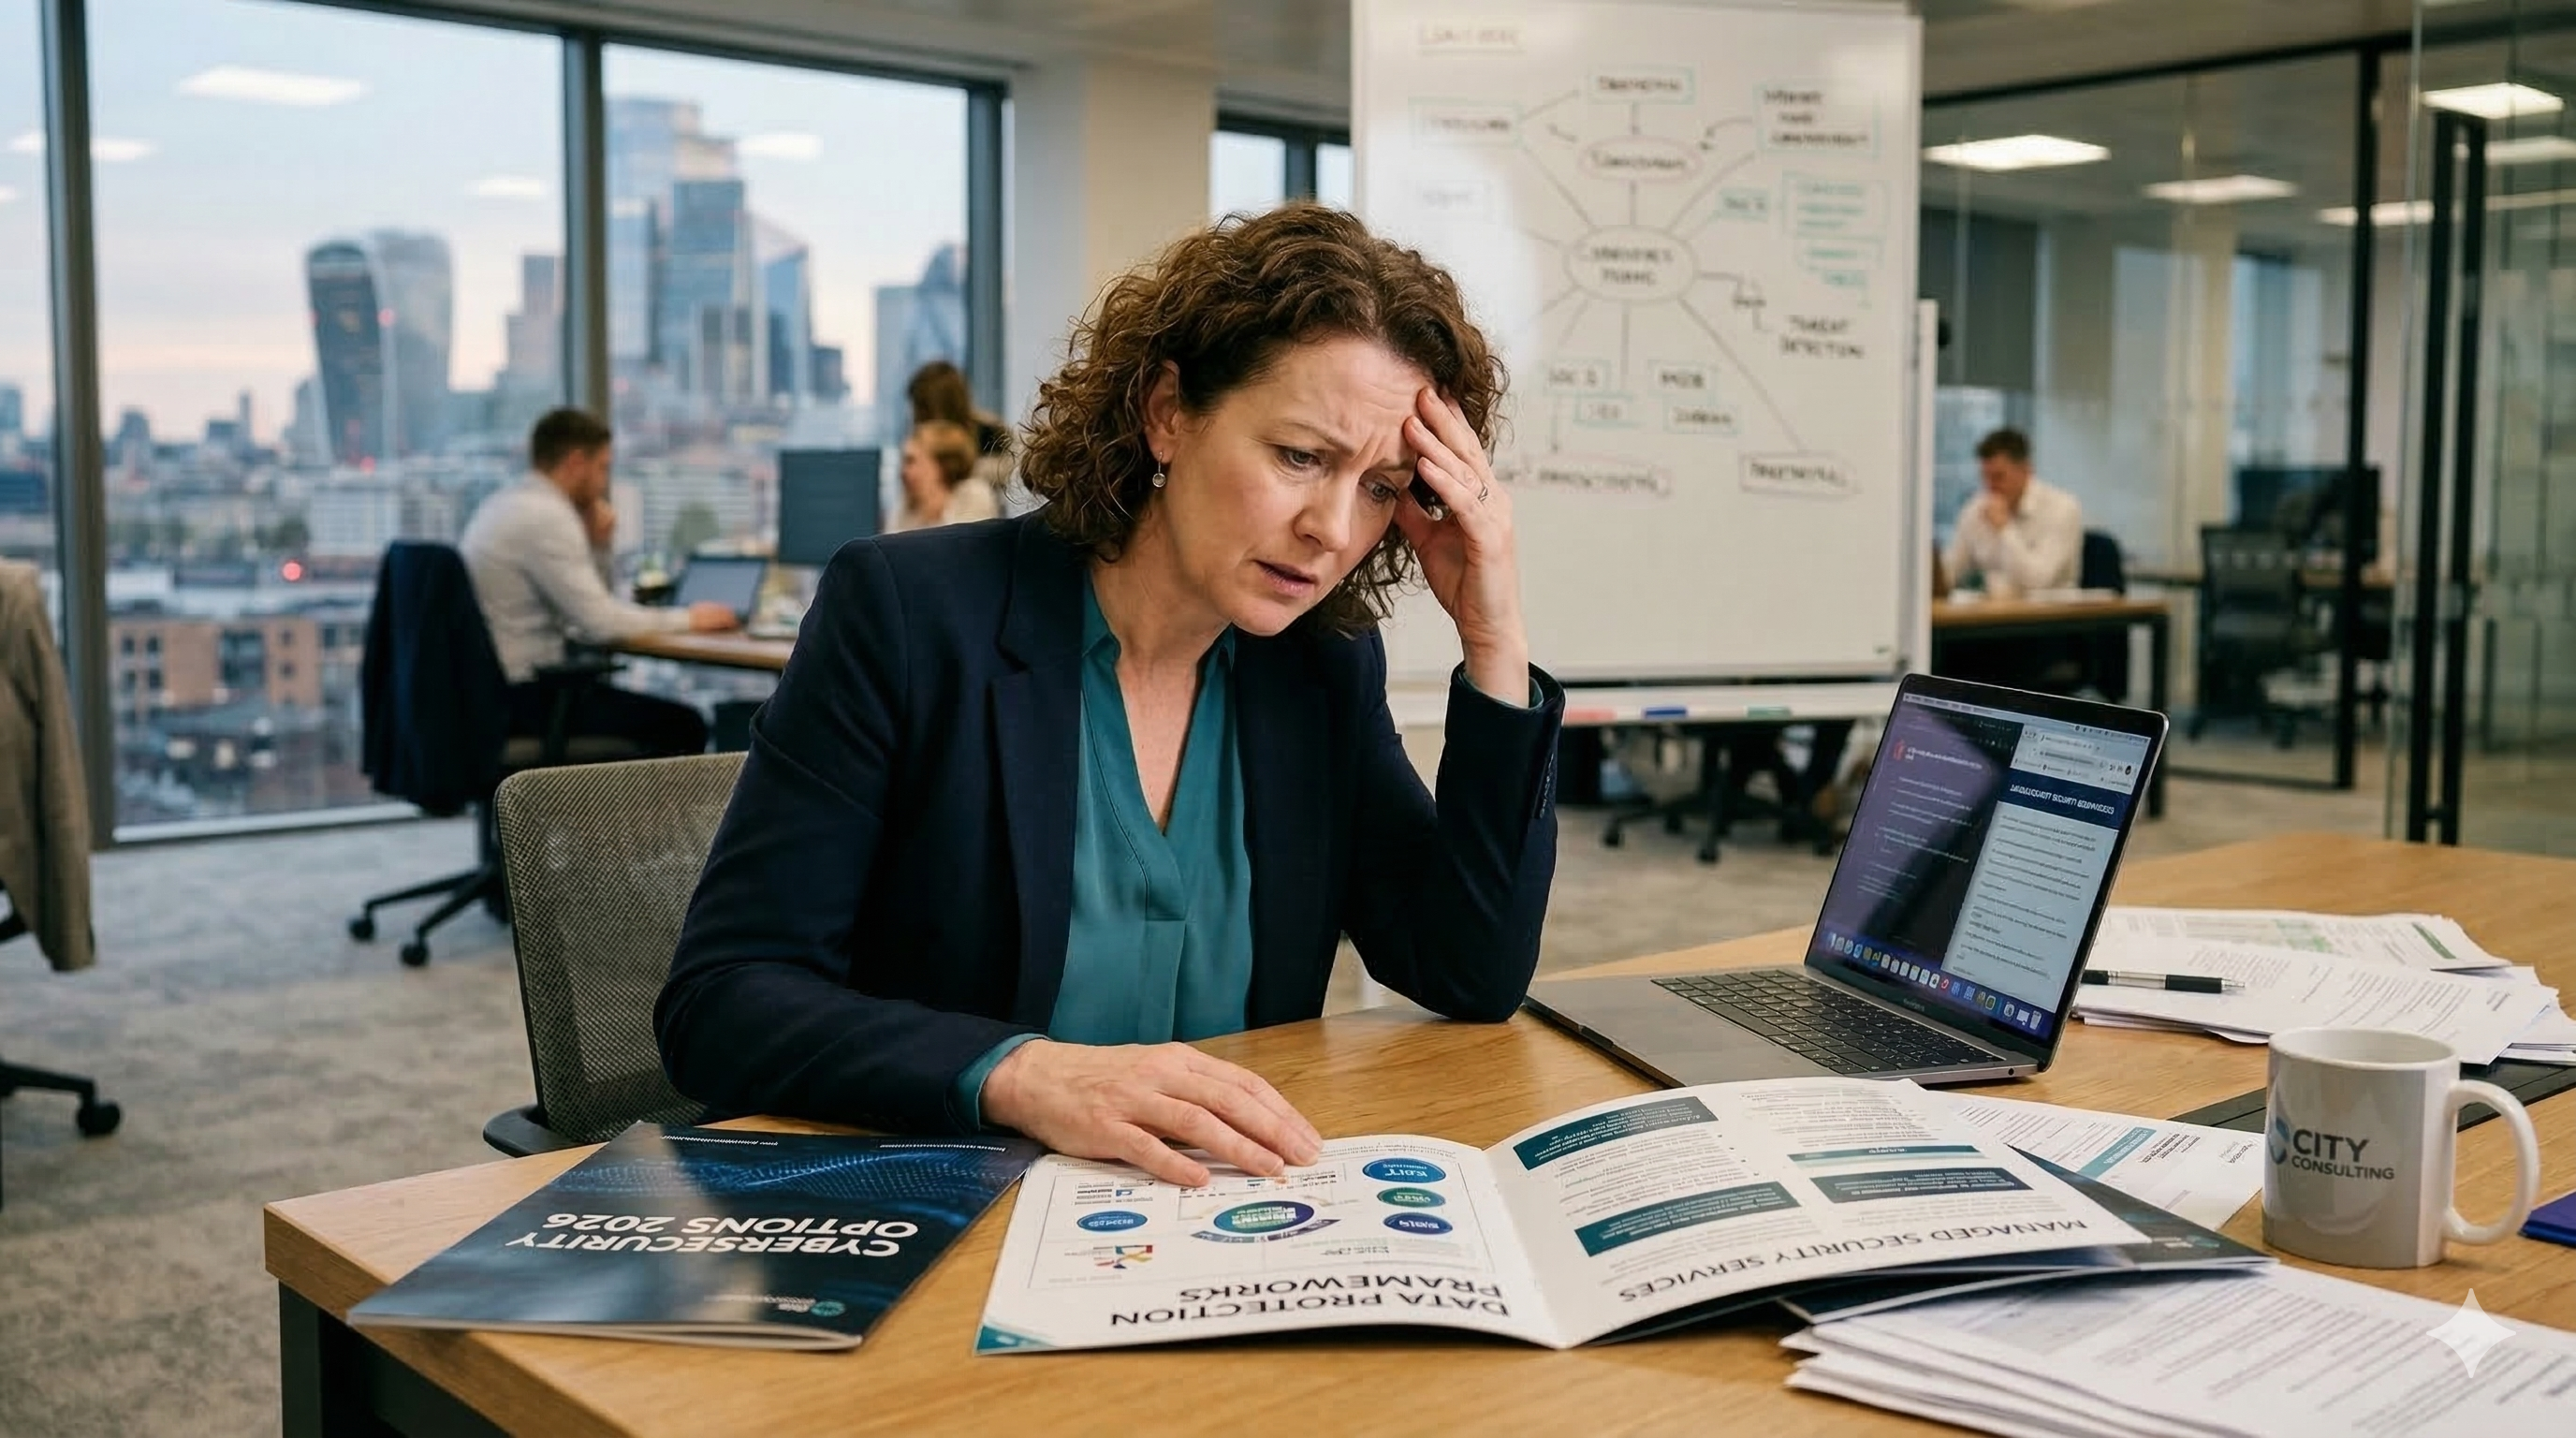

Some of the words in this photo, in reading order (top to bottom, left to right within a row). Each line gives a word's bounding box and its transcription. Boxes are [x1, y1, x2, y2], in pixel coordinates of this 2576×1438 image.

[2293, 1129, 2369, 1162] CITY
[2291, 1155, 2394, 1180] CONSULTING
[542, 1213, 675, 1232] 2026
[681, 1217, 918, 1238] OPTIONS
[1931, 1220, 2088, 1241] MANAGED
[505, 1232, 900, 1256] CYBERSECURITY
[1776, 1233, 1922, 1263] SECURITY
[1619, 1256, 1764, 1302] SERVICES
[1112, 1294, 1383, 1325] PROTECTION
[1398, 1293, 1510, 1317] DATA
